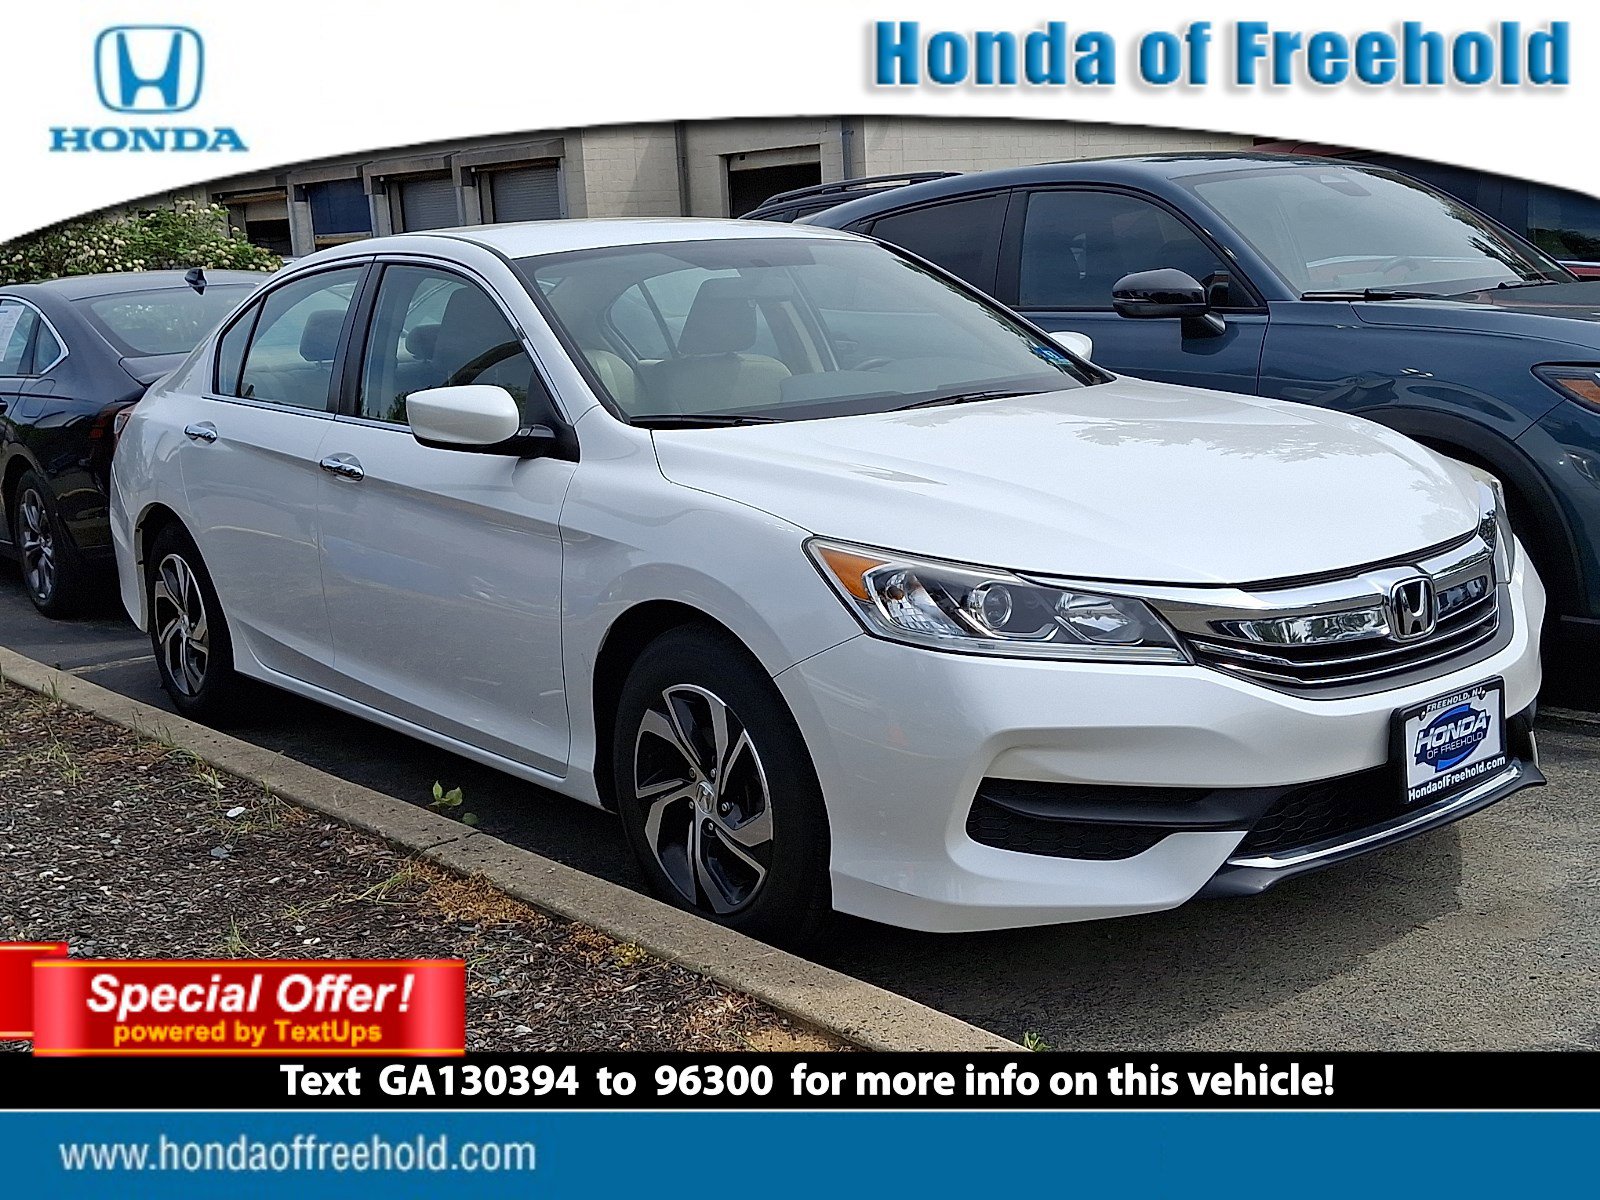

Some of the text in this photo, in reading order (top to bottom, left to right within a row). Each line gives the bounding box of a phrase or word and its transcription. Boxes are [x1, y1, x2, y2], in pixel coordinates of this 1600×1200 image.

[1415, 711, 1488, 755] HONDA
[1426, 731, 1484, 760] OF FREEHOLD
[1408, 755, 1506, 802] HondaofFreehold.com
